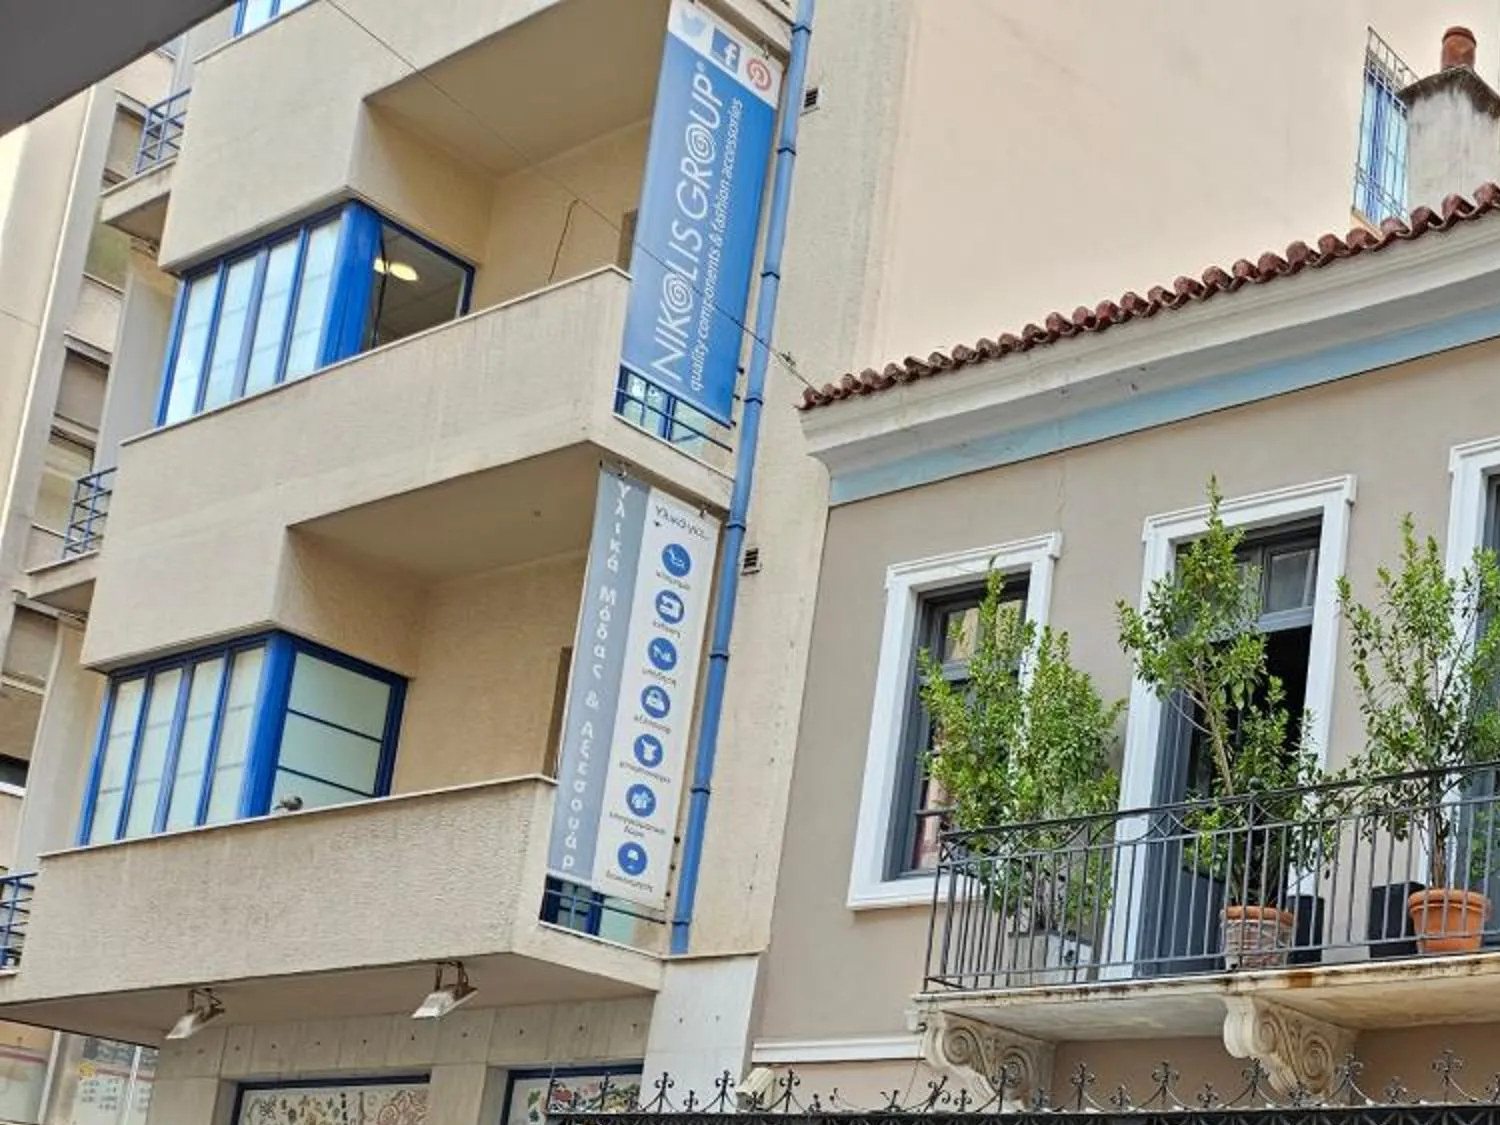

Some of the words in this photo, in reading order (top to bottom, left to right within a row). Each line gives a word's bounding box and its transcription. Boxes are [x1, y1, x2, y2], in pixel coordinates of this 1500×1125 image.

[722, 97, 745, 176] accessories
[715, 174, 737, 231] fashion
[650, 220, 703, 381] NIKOLIS
[696, 243, 724, 338] components
[690, 338, 709, 391] quality
